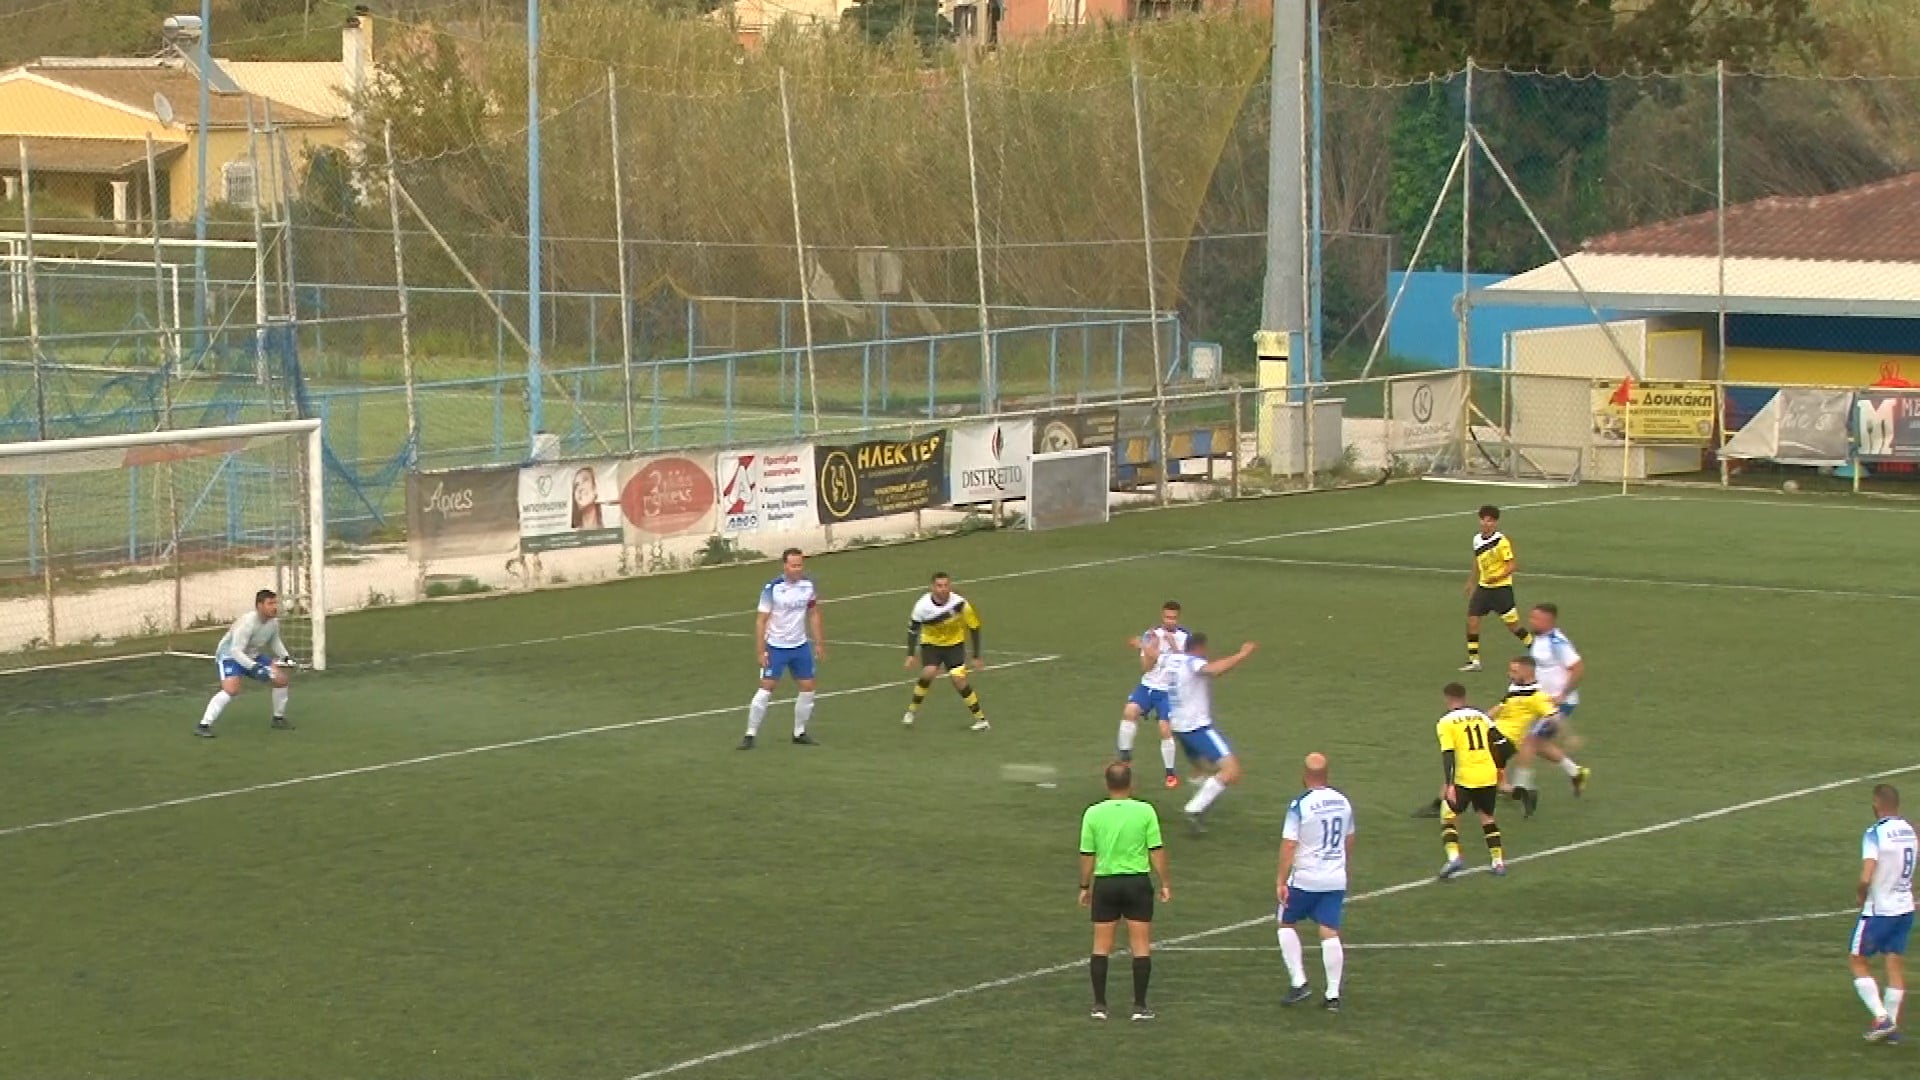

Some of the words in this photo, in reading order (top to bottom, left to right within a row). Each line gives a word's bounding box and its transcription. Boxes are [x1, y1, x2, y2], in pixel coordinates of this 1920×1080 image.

[1642, 391, 1712, 406] Δουκάκη
[962, 465, 1022, 490] DISTRETTO
[1463, 724, 1485, 751] 11
[1320, 816, 1342, 849] 18
